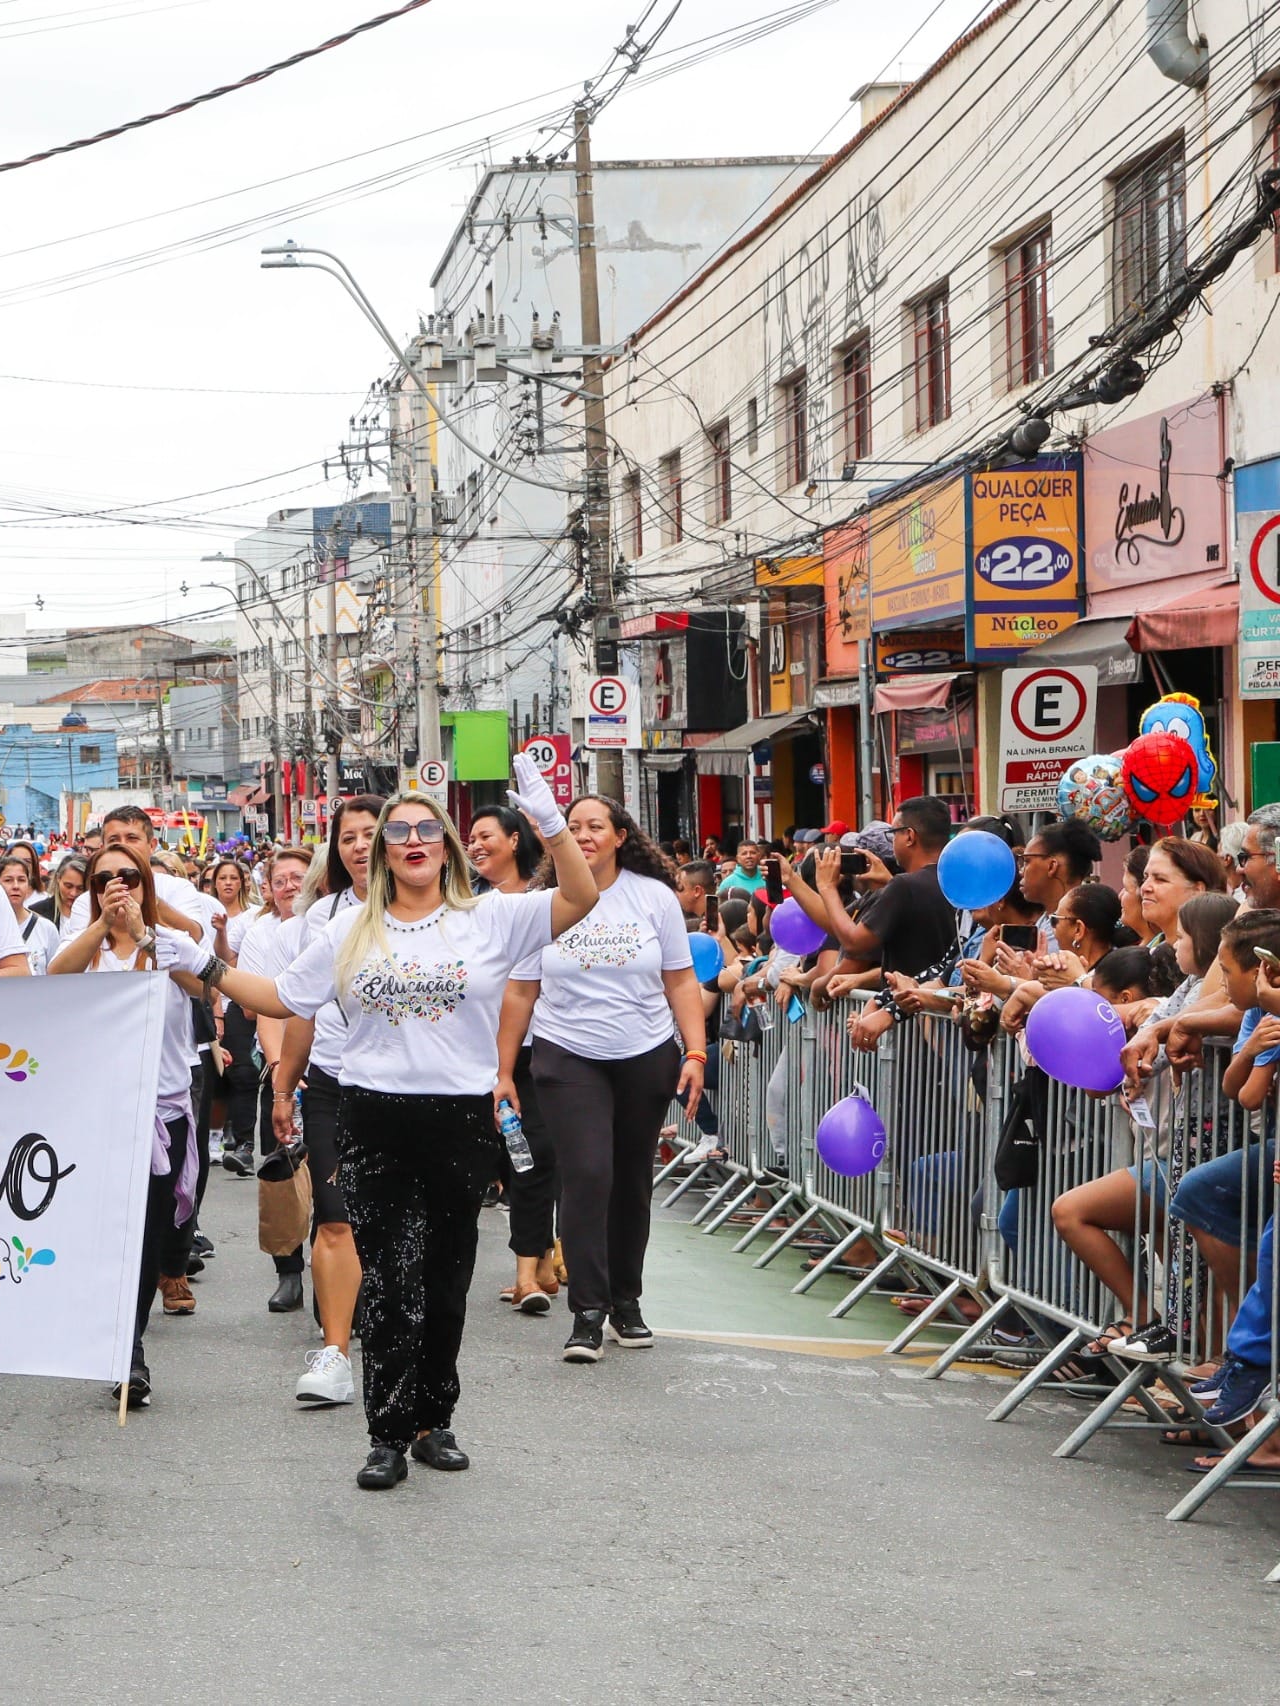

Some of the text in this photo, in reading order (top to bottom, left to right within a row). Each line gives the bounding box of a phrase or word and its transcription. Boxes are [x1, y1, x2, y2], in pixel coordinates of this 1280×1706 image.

[973, 478, 1073, 499] QUALQUER
[999, 502, 1046, 527] PEÇA
[991, 616, 1059, 631] Núcleo
[1022, 631, 1059, 640] MODA
[600, 686, 615, 709] E
[1034, 685, 1063, 727] E
[528, 747, 553, 762] 30
[1006, 744, 1086, 756] NA LINHA BRANCA
[1032, 760, 1062, 770] VAGA
[428, 766, 438, 781] E
[334, 800, 341, 809] E
[563, 931, 634, 950] Educação
[362, 975, 458, 999] Educação
